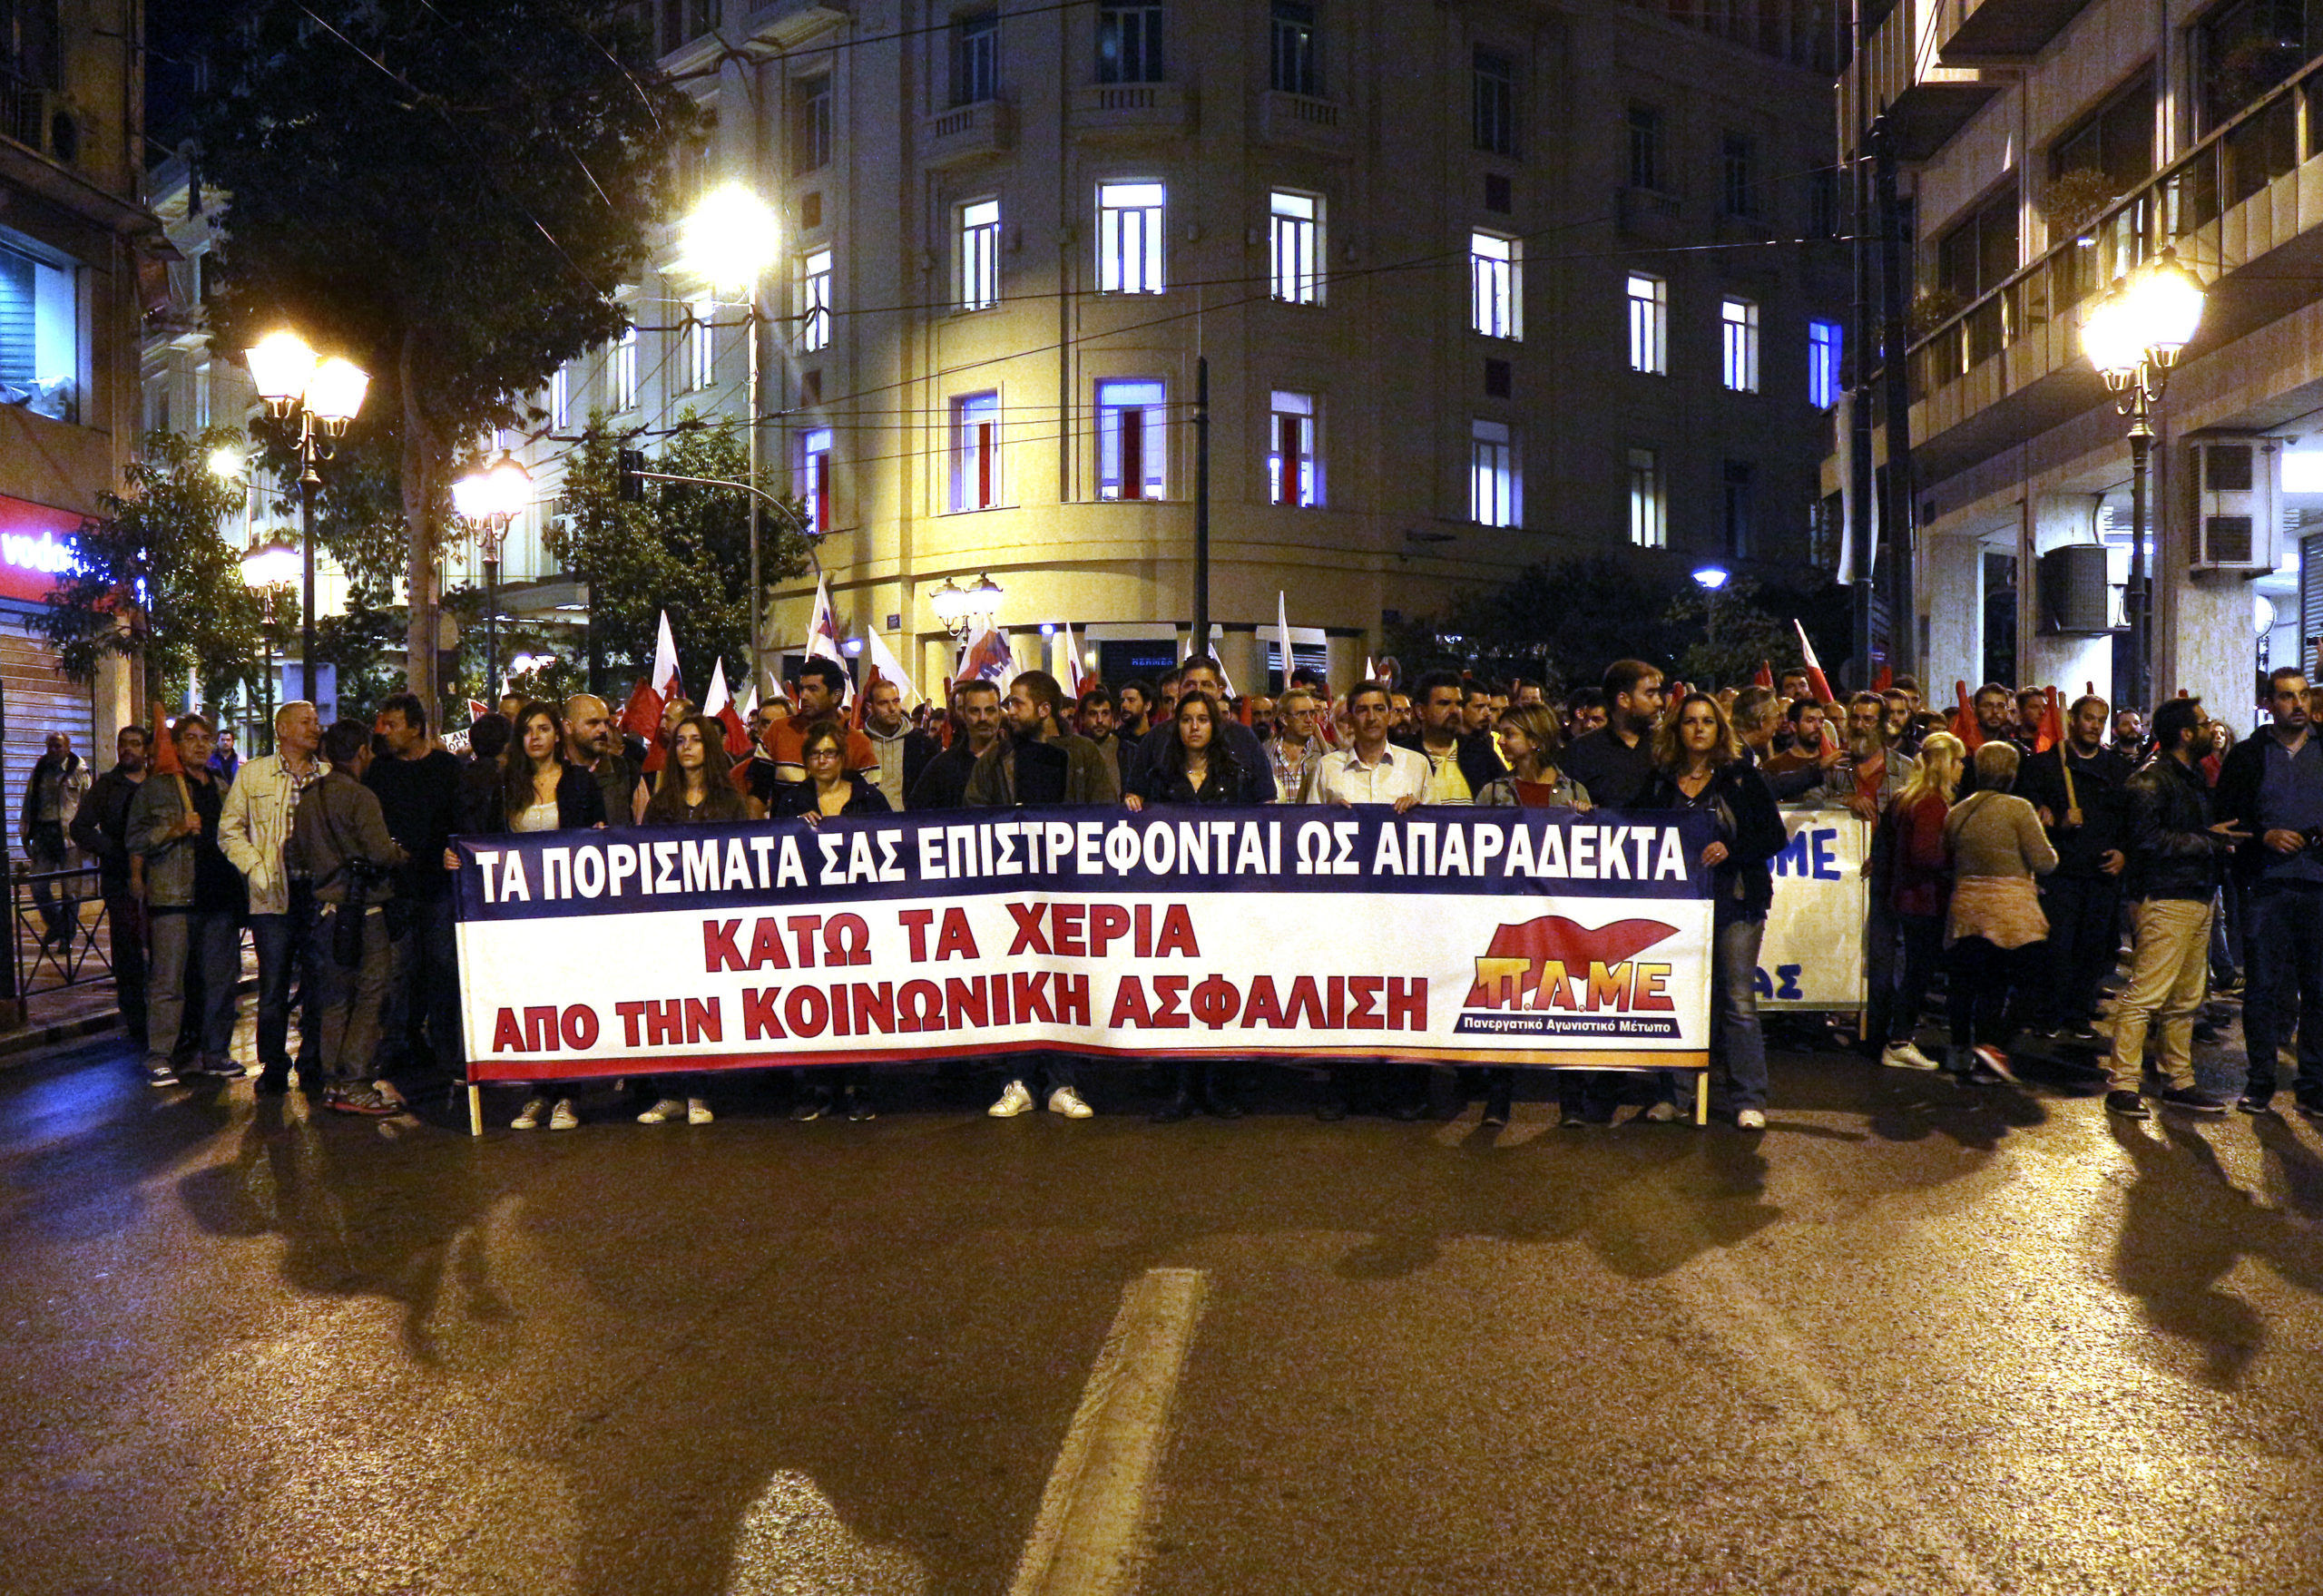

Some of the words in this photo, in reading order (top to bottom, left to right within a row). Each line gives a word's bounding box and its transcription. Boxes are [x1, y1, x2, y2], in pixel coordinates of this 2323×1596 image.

[475, 850, 531, 904] ΤΑ
[543, 836, 809, 901] ΠΟΡΙΣΜΑΤΑ
[818, 829, 906, 886] ΣΑΣ
[917, 820, 1281, 880] ΕΠΙΣΤΡΕΦΟΝΤΑΙ
[1297, 820, 1360, 875] ΩΣ
[1372, 822, 1688, 881] ΑΠΑΡΑΔΕΚΤΑ
[1767, 828, 1841, 881] ΜΕ
[703, 913, 872, 973] ΚΑΤΩ
[899, 907, 980, 963] ΤΑ
[1007, 903, 1201, 958] ΧΕΡΙΑ
[493, 1004, 600, 1053] ΑΠΟ
[615, 997, 722, 1048] ΤΗΝ
[742, 972, 1092, 1041] ΚΟΙΝΩΝΙΚΗ
[1109, 974, 1428, 1032] ΑΣΦΑΛΙΣΗ
[1464, 1017, 1543, 1036] Πανεργατικό
[1546, 1018, 1616, 1034] Αγωνιστικό
[1619, 1020, 1671, 1034] Μέτωπο
